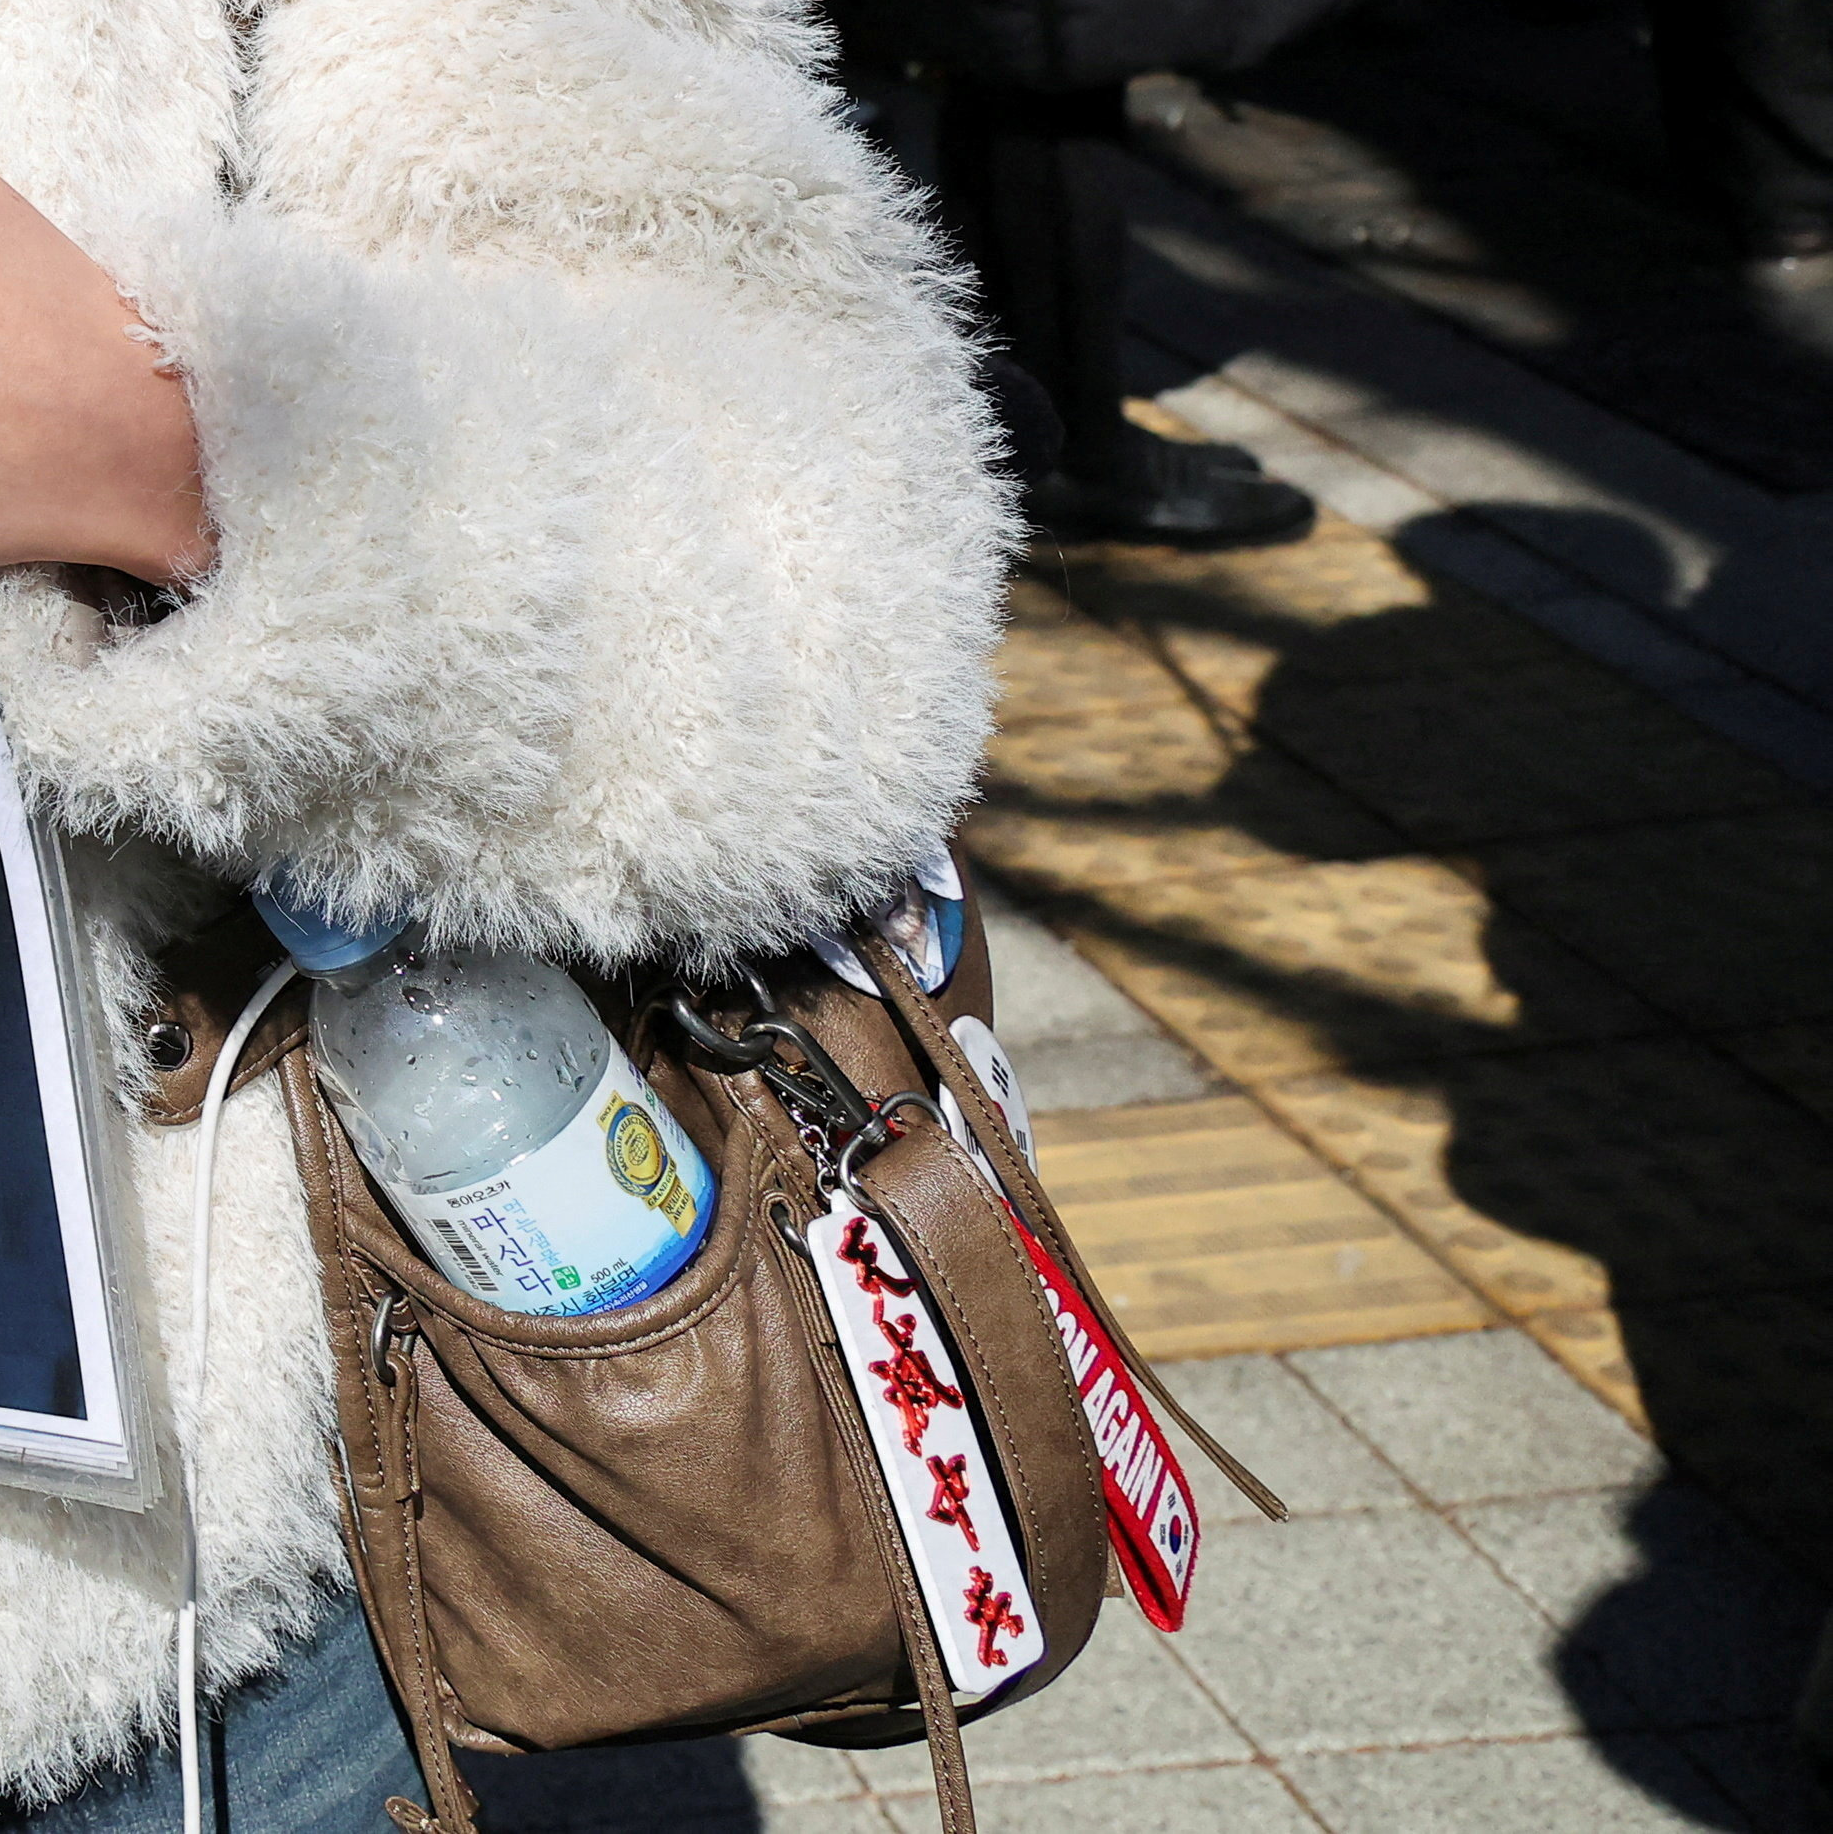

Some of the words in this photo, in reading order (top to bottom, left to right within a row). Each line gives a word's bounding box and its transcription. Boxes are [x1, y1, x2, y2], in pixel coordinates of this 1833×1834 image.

[446, 1180, 511, 1209] 동아오츠카
[648, 1180, 668, 1207] GRAND
[664, 1183, 684, 1216] QUALITY
[673, 1193, 690, 1224] AWARD
[470, 1207, 553, 1296] 마신다
[482, 1250, 504, 1277] water
[582, 1264, 640, 1307] 화북면
[590, 1266, 611, 1284] 500
[613, 1258, 629, 1273] mL
[1081, 1366, 1164, 1521] AGAIN
